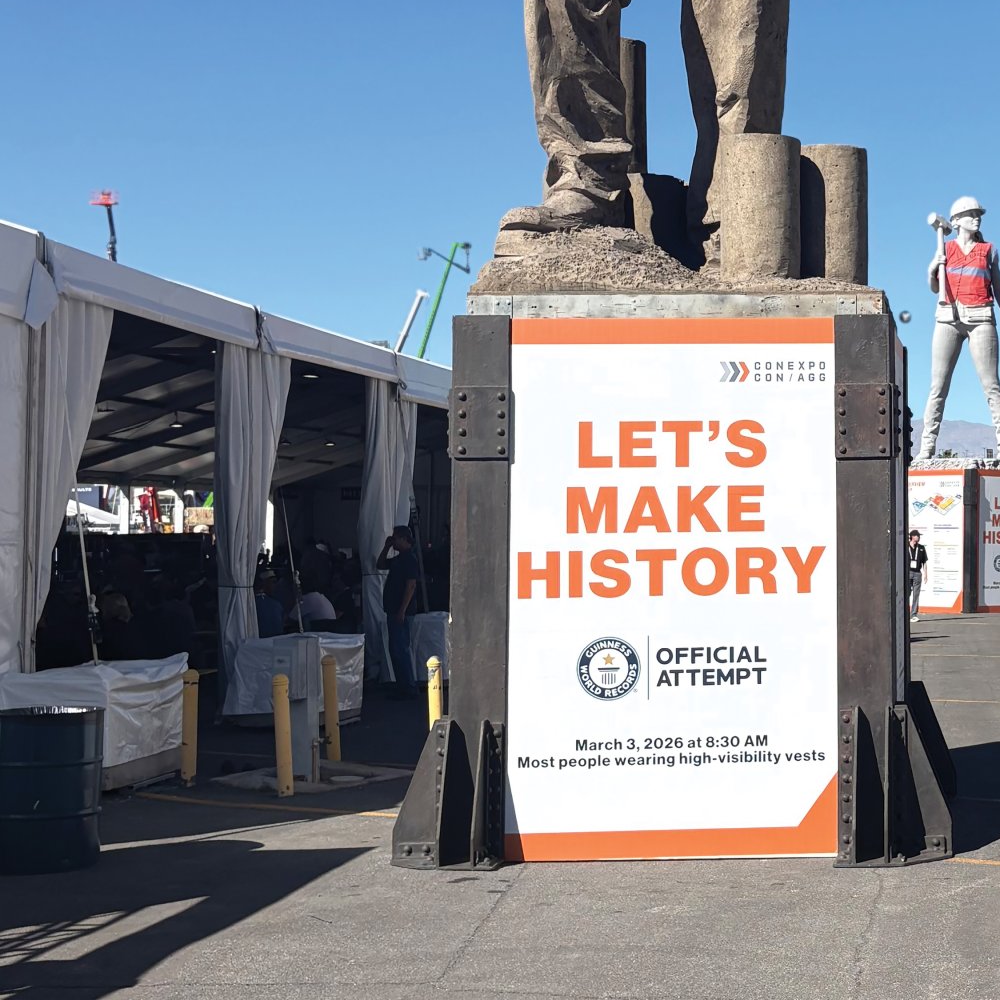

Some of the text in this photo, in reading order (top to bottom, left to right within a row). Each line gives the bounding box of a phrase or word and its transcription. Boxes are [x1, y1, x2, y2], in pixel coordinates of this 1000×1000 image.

[754, 361, 826, 371] CONEXPO
[754, 373, 826, 382] CON/AGG
[577, 419, 768, 469] LET’S
[565, 485, 766, 534] MAKE
[517, 545, 827, 600] HISTORY
[585, 640, 632, 658] GUINNESS
[656, 646, 767, 665] OFFICIAL
[580, 663, 637, 698] WORLD RECORDS
[656, 667, 767, 687] ATTEMPT
[575, 735, 768, 752] March 3, 2026 at 8:30 AM
[517, 750, 826, 770] Most people wearing high-visibility vests
